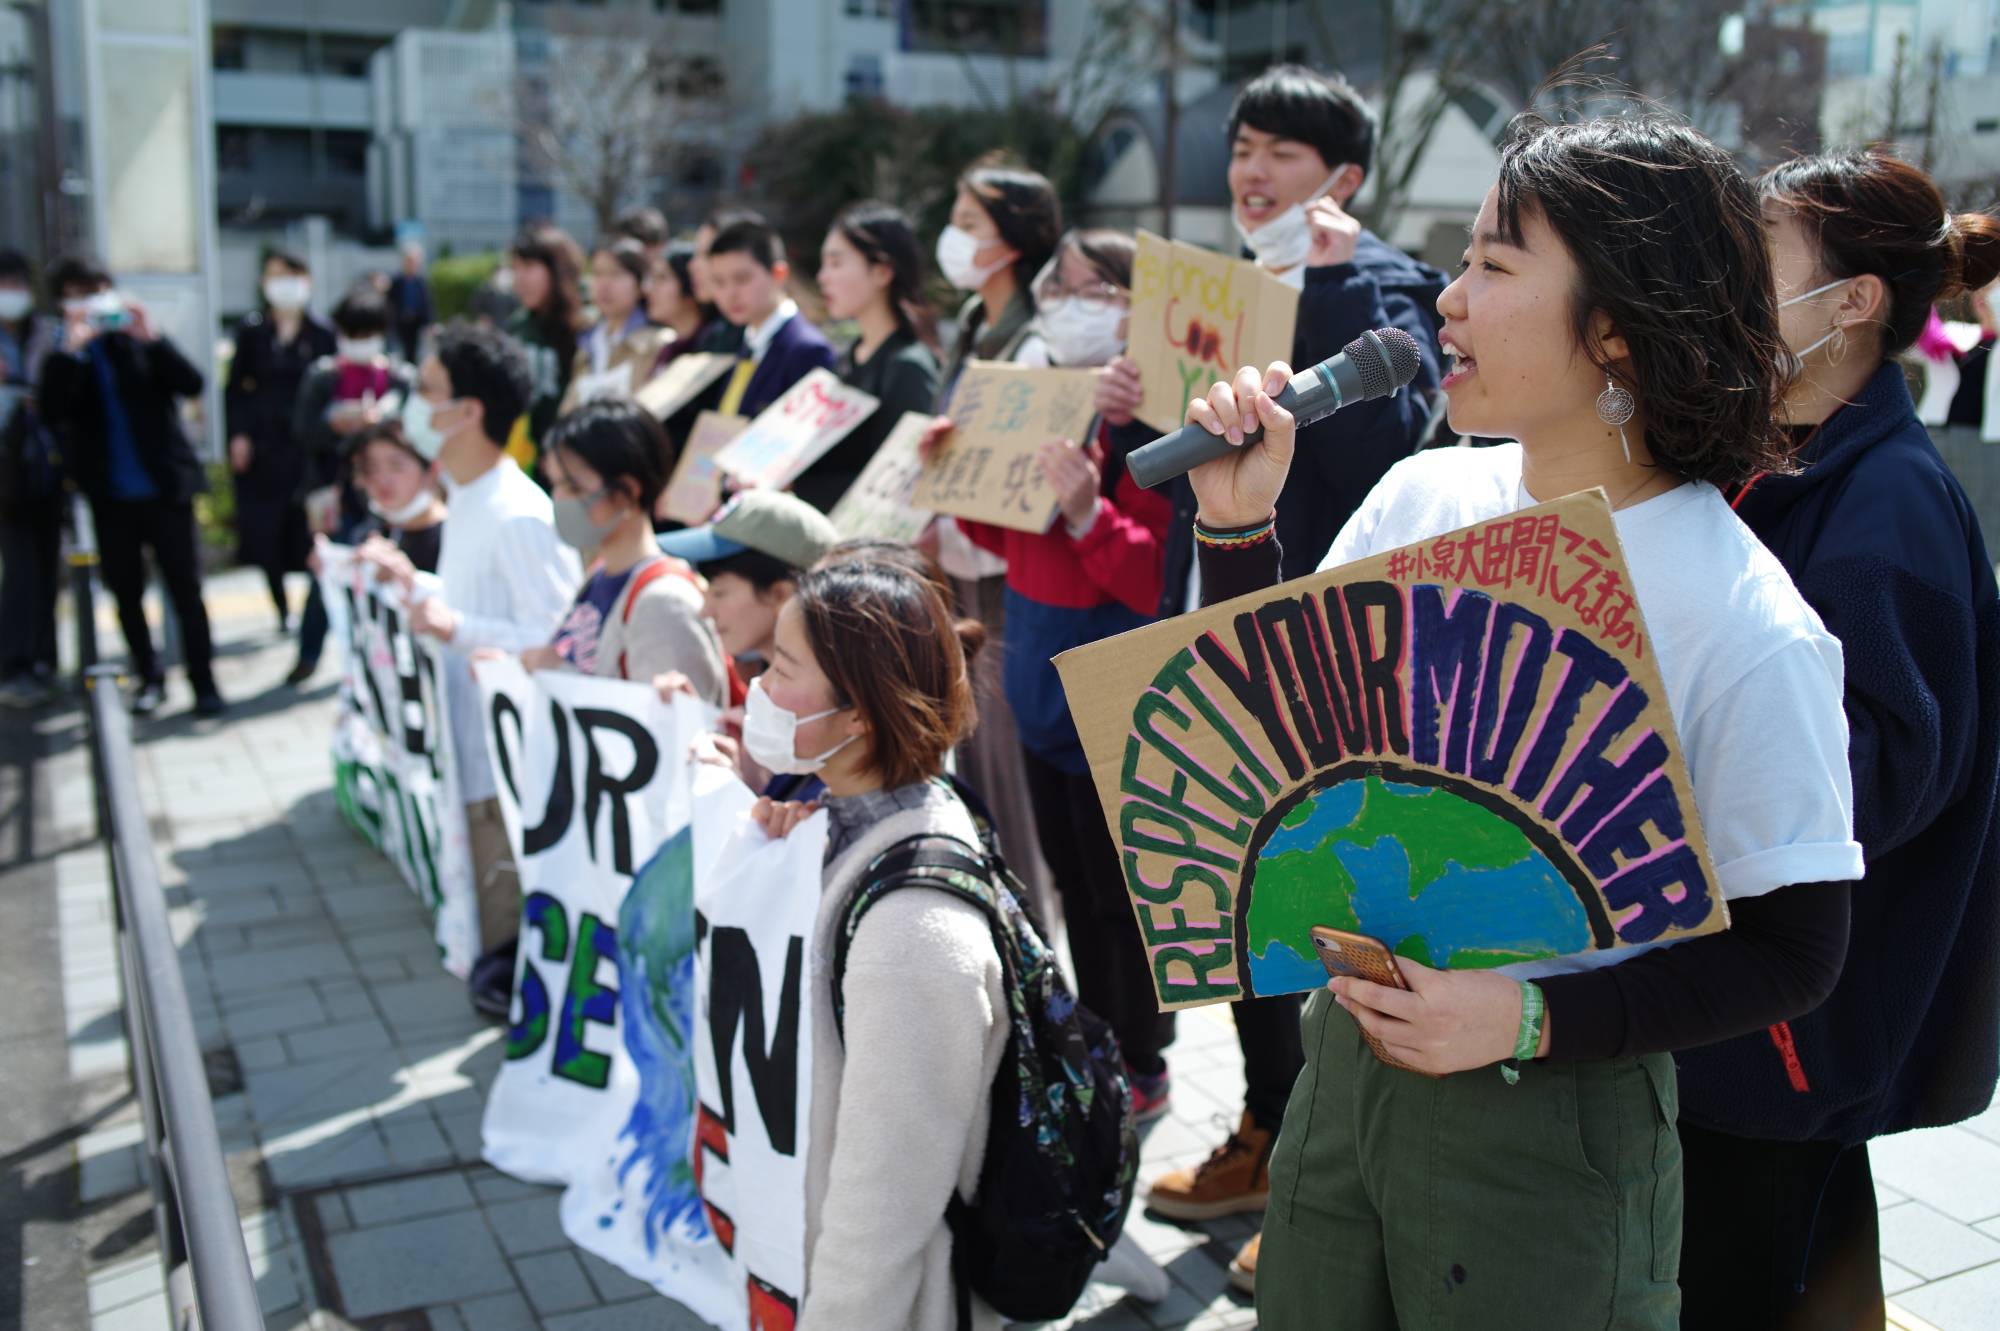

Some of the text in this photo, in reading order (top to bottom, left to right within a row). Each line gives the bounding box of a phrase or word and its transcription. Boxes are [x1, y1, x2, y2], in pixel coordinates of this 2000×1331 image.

[1120, 581, 1713, 1004] RESPECT YOUR MOTHER
